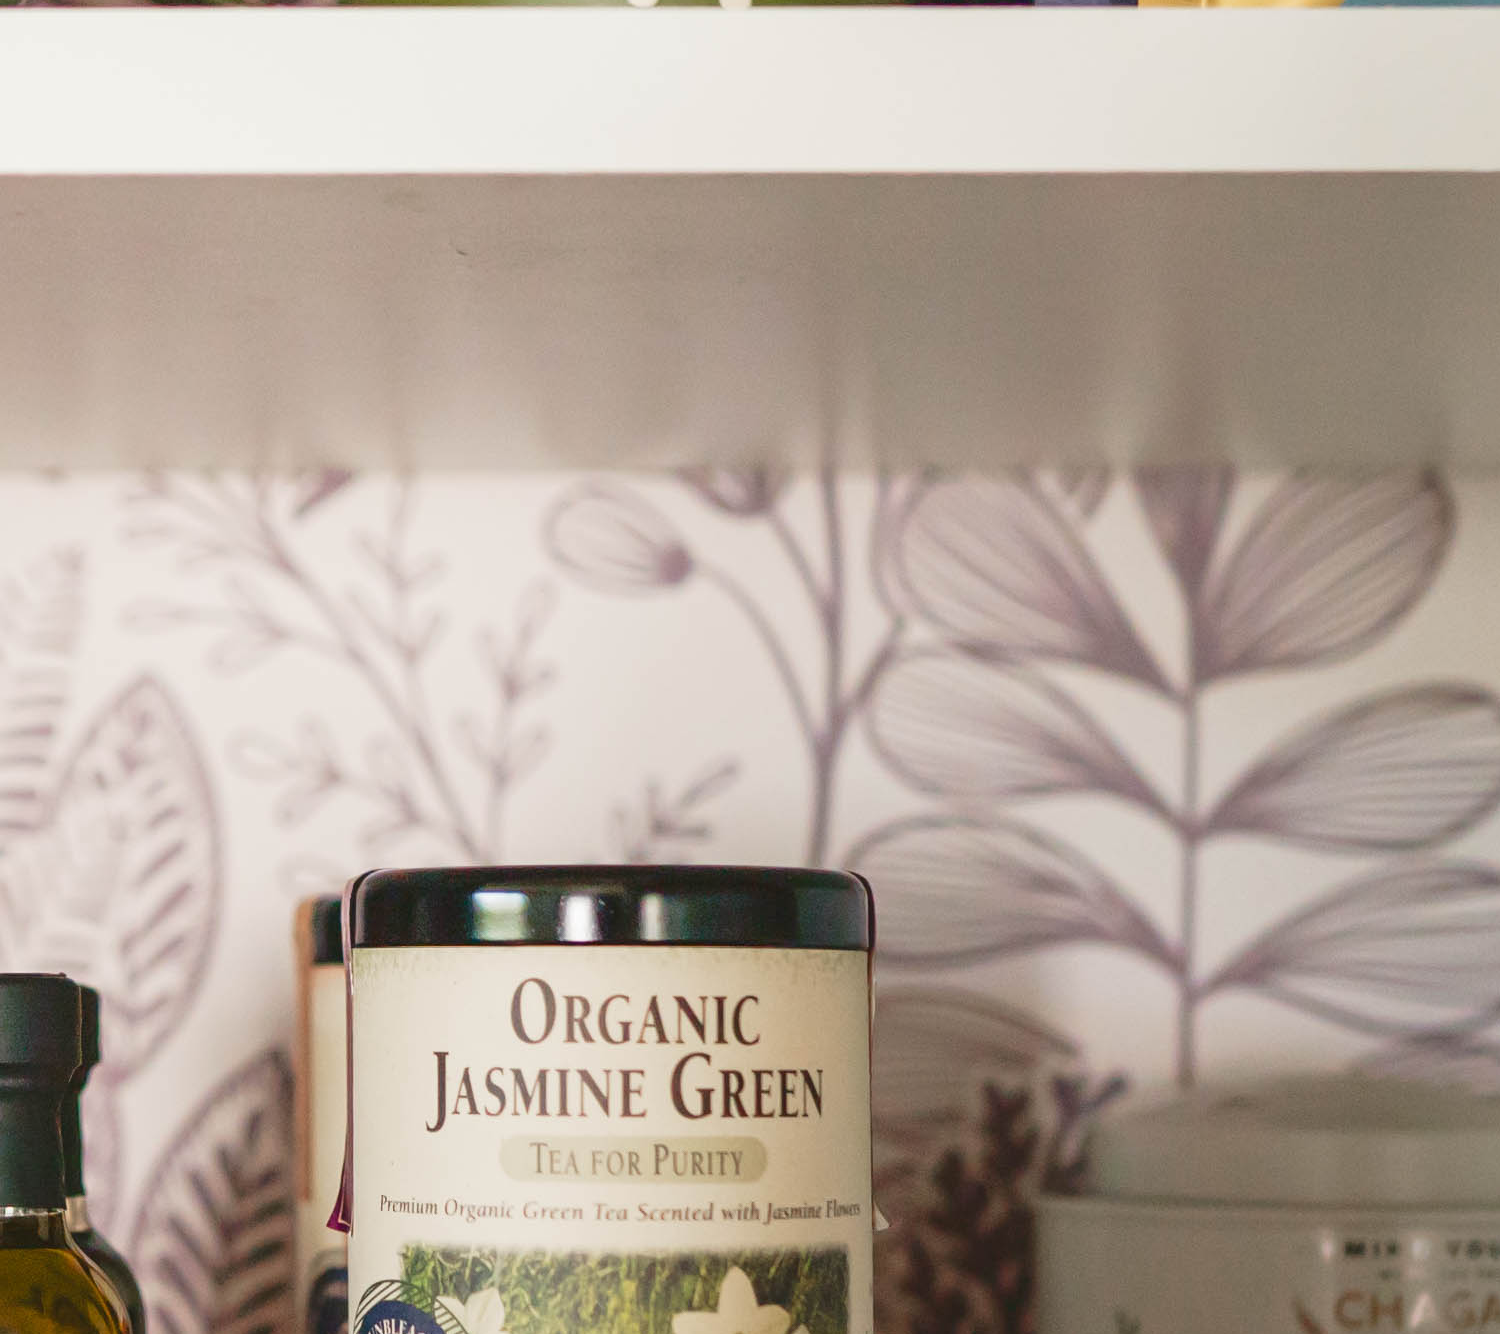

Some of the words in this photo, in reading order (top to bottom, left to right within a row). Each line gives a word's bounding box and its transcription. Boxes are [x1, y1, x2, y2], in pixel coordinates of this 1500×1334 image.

[510, 977, 761, 1046] ORGANIC
[426, 1051, 647, 1133] JASMINE
[669, 1051, 824, 1120] GREEN
[530, 1142, 580, 1175] TEA
[590, 1150, 641, 1175] FOR
[653, 1143, 744, 1176] PURITY
[380, 1194, 438, 1216] Premium
[444, 1199, 515, 1222] Organic
[522, 1201, 583, 1222] Green
[594, 1202, 629, 1222] Tea
[636, 1202, 714, 1222] Scented
[721, 1201, 760, 1221] with
[763, 1200, 822, 1224] Jasmine
[825, 1198, 861, 1219] Flowers
